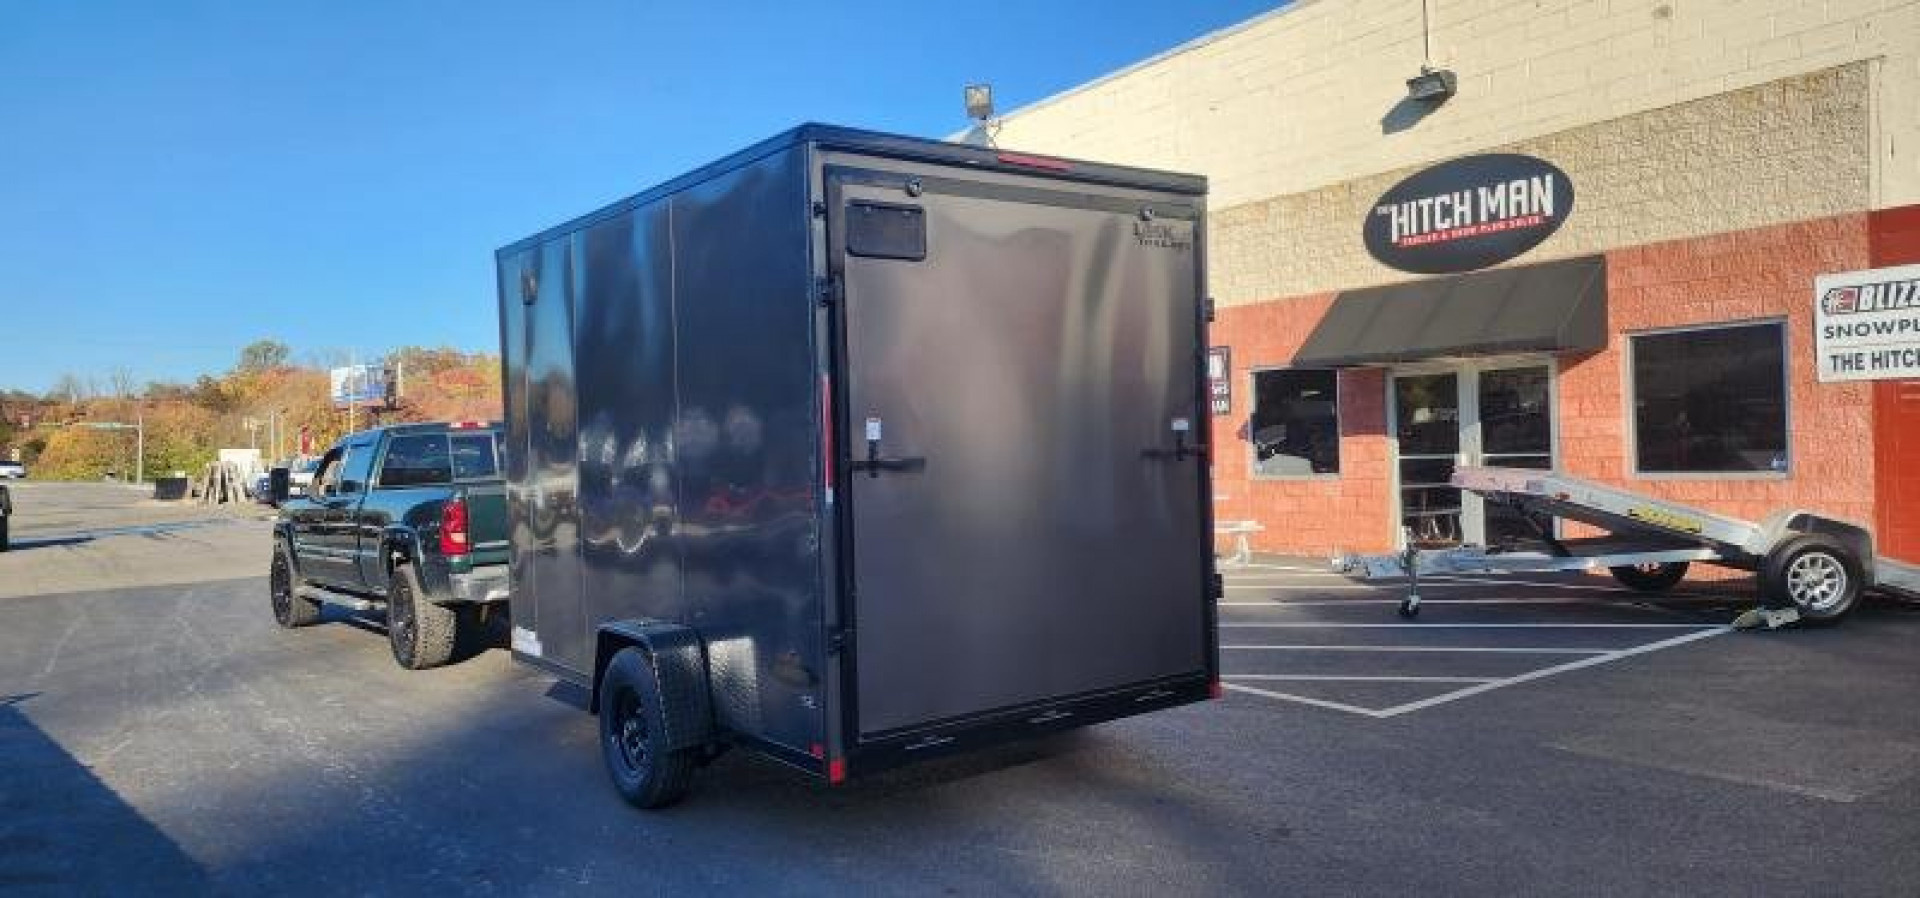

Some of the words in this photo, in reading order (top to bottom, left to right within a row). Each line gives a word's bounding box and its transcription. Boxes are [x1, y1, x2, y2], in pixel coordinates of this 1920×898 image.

[1391, 189, 1472, 243] HITCH
[1478, 173, 1554, 222] MAN
[1829, 351, 1866, 373] THE
